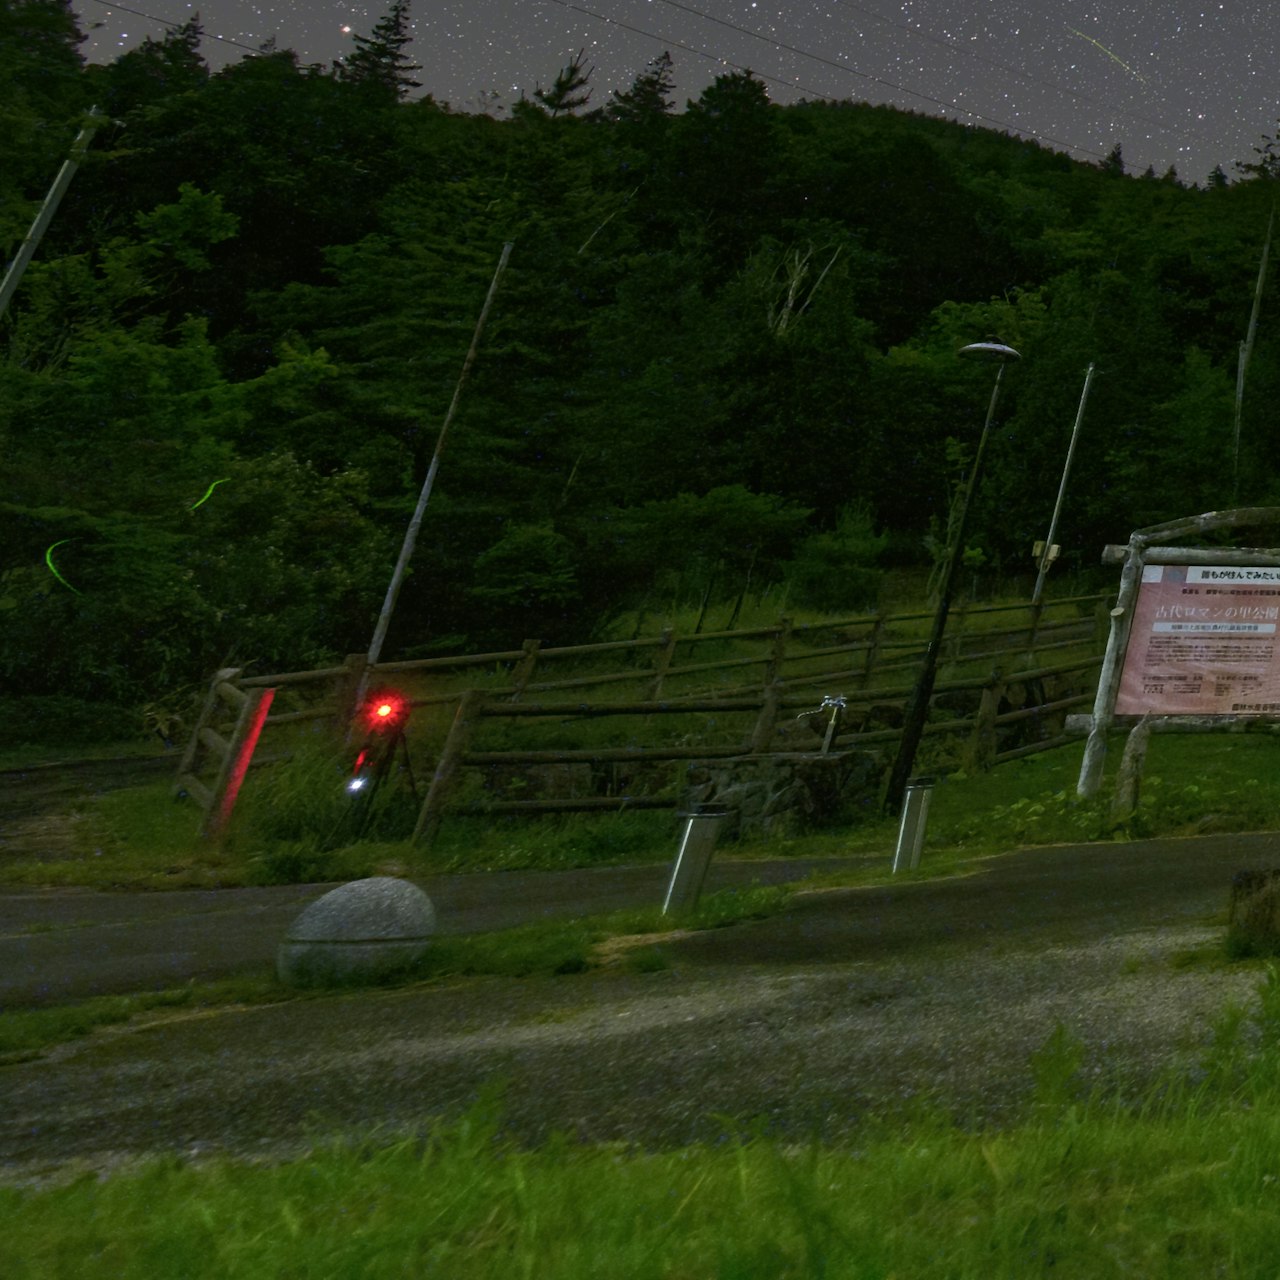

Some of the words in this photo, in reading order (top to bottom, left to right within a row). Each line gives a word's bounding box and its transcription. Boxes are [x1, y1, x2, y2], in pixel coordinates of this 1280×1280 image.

[1155, 605, 1280, 620] 古代ロマンの里公園
